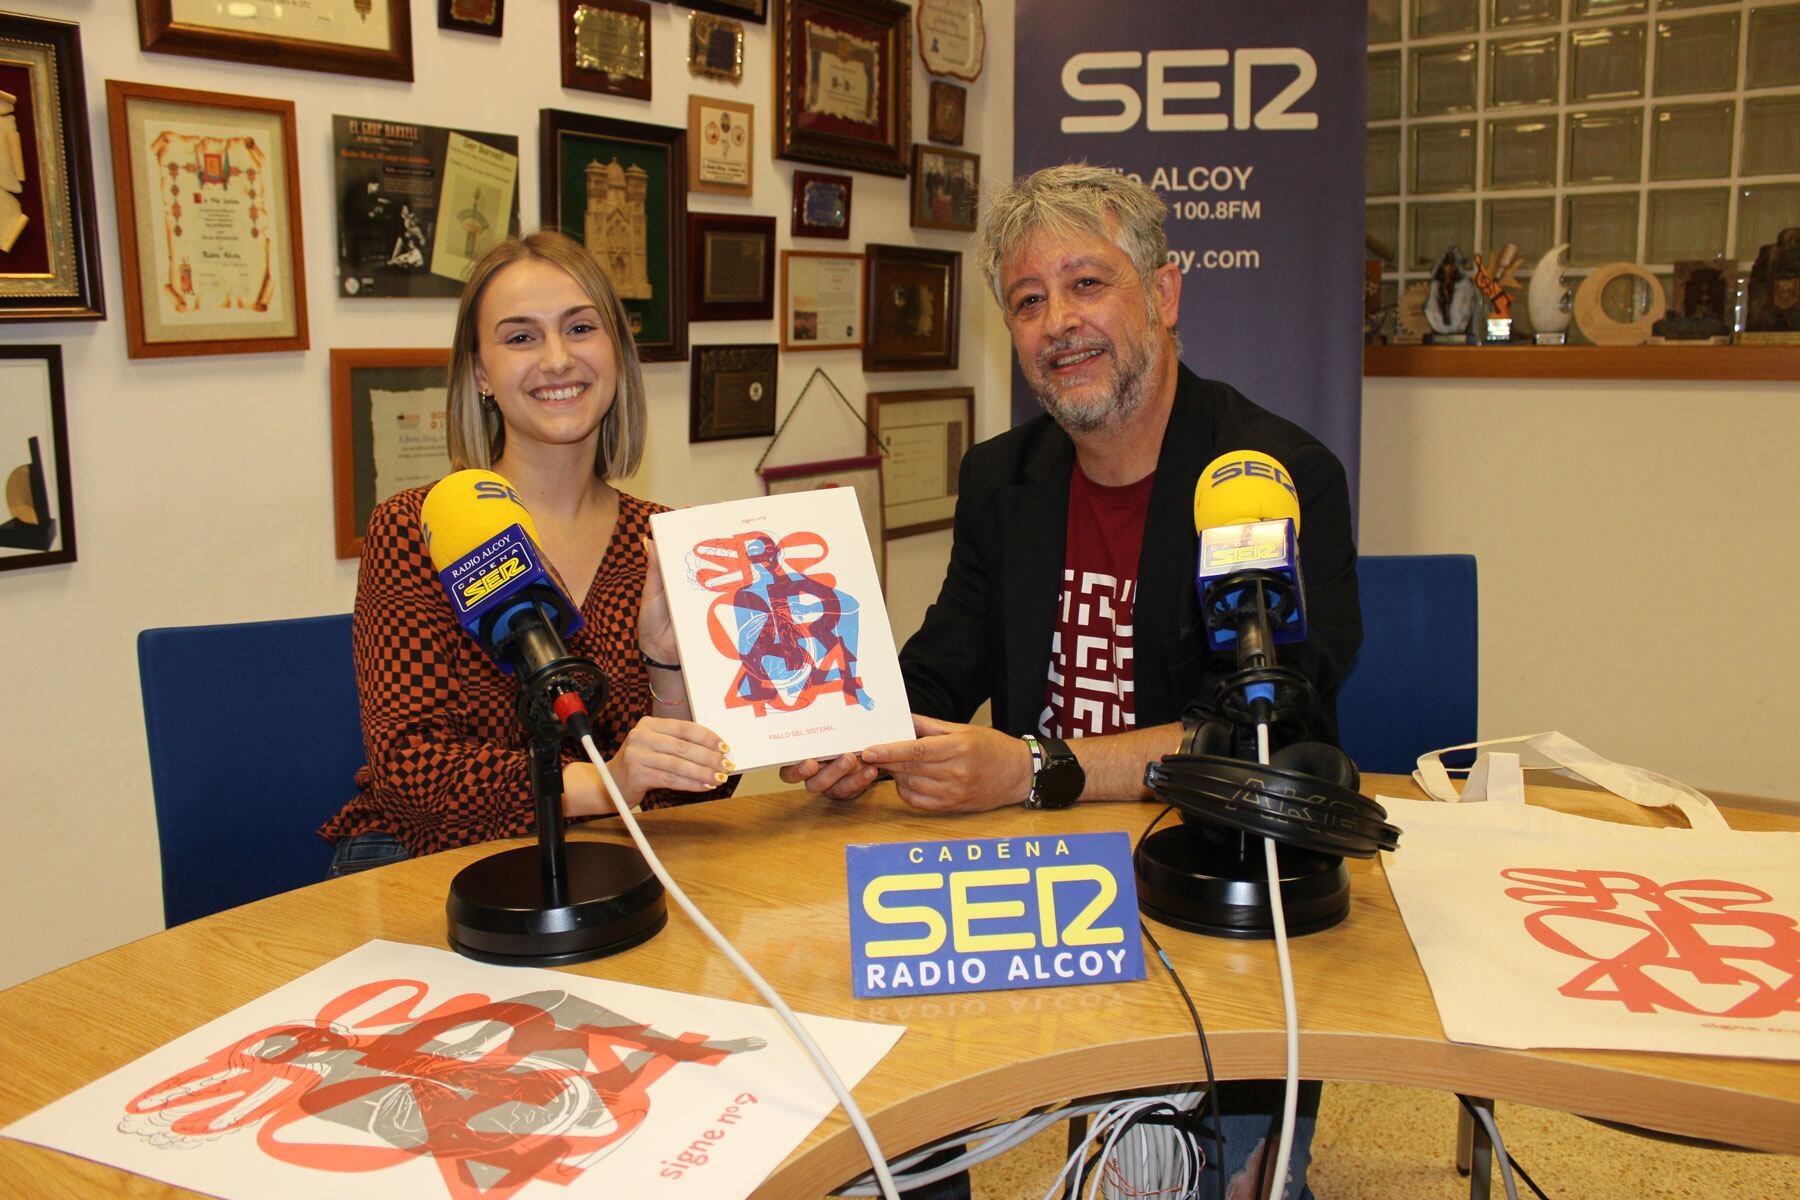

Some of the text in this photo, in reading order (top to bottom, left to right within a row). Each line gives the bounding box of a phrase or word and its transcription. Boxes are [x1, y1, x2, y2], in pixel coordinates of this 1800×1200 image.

[1060, 47, 1320, 133] SER
[1151, 166, 1254, 191] ALCOY
[1173, 201, 1261, 220] 100.8FM
[1166, 247, 1260, 274] oy.com
[452, 534, 511, 578] RADIO ALCOY
[458, 548, 519, 590] CADENA
[1209, 543, 1280, 567] SER
[463, 557, 527, 607] SER
[768, 731, 791, 741] FALLO
[791, 729, 805, 738] DEL
[908, 839, 1070, 864] CADENA
[862, 863, 1125, 958] SER
[866, 948, 1127, 990] RADIO ALCOY
[659, 1129, 725, 1181] signe
